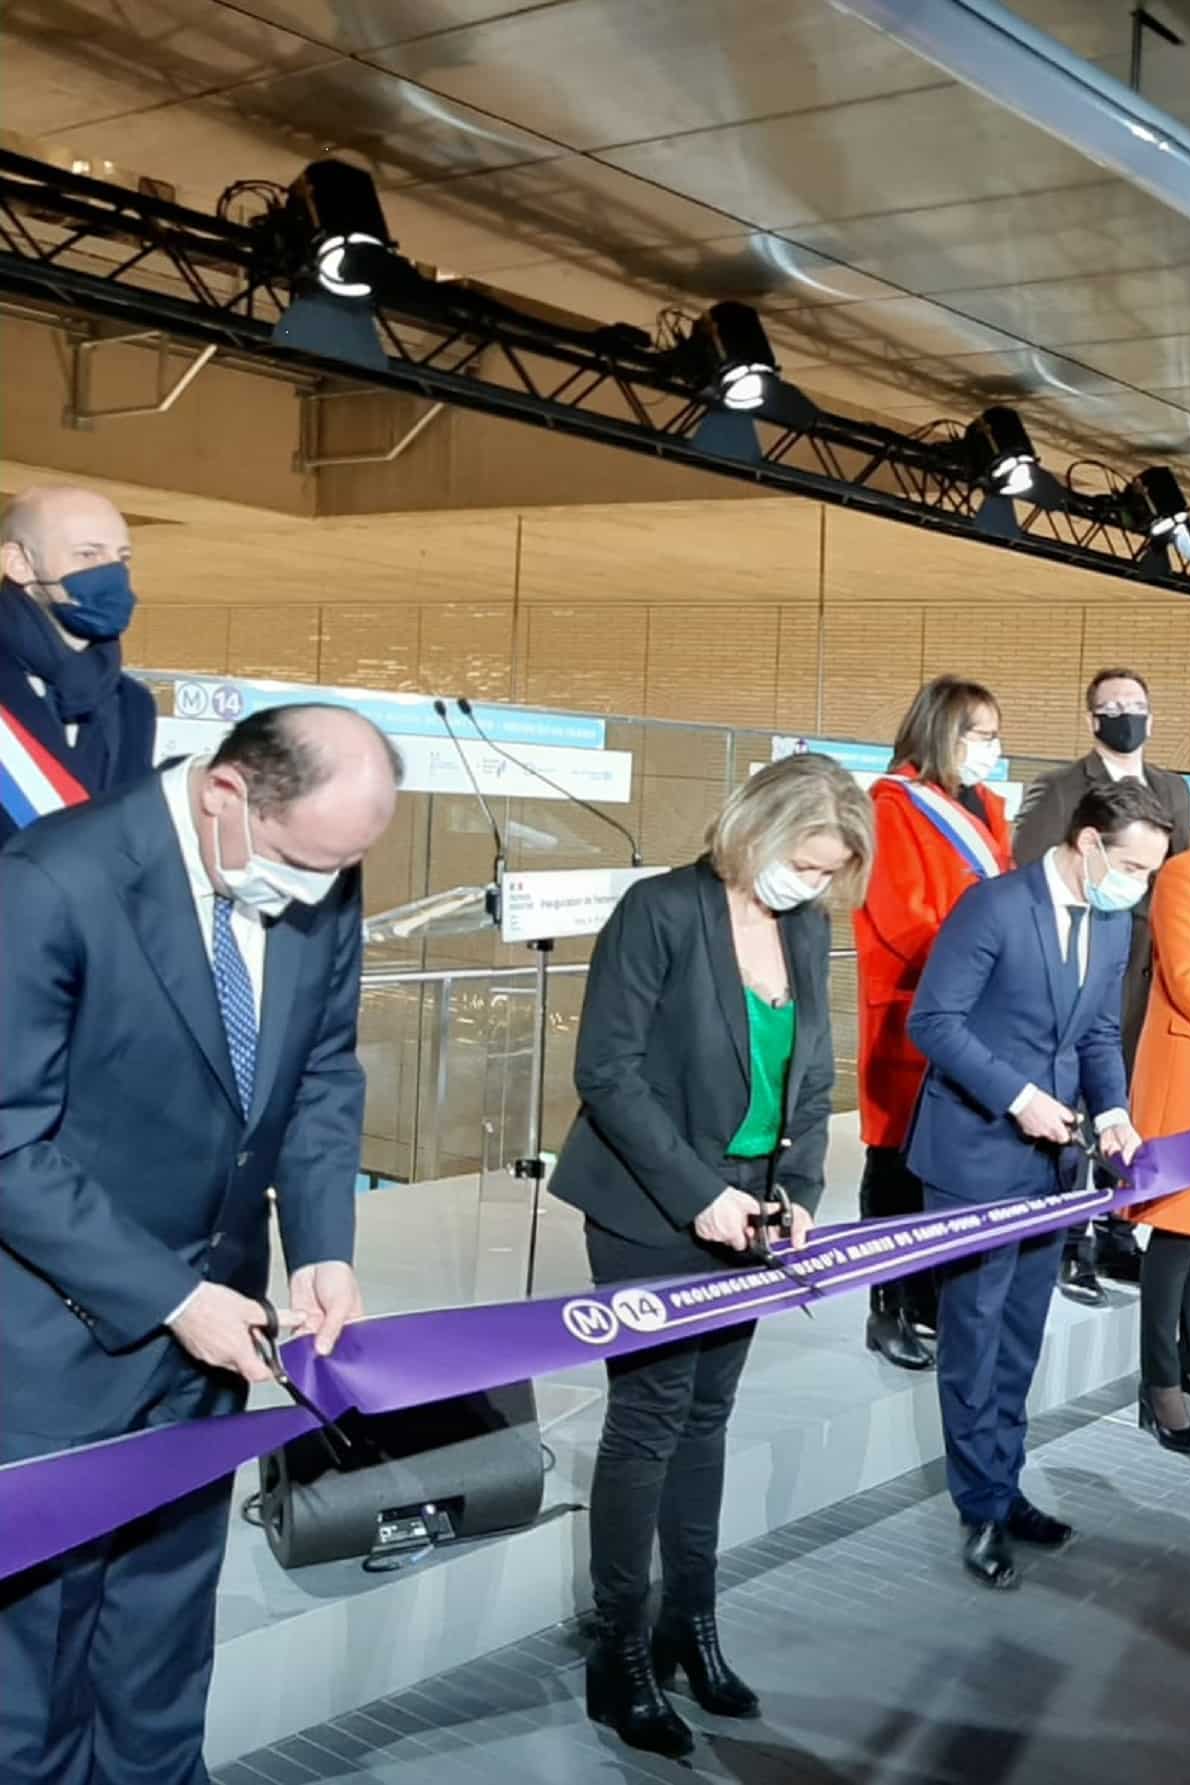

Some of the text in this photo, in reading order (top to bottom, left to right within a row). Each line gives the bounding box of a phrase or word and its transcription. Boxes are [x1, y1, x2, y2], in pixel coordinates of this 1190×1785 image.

[216, 692, 239, 715] 14
[570, 1304, 609, 1336] M
[619, 1296, 658, 1322] 14
[669, 1269, 786, 1308] PROLONGEMENT
[786, 1248, 847, 1276] USQU'À
